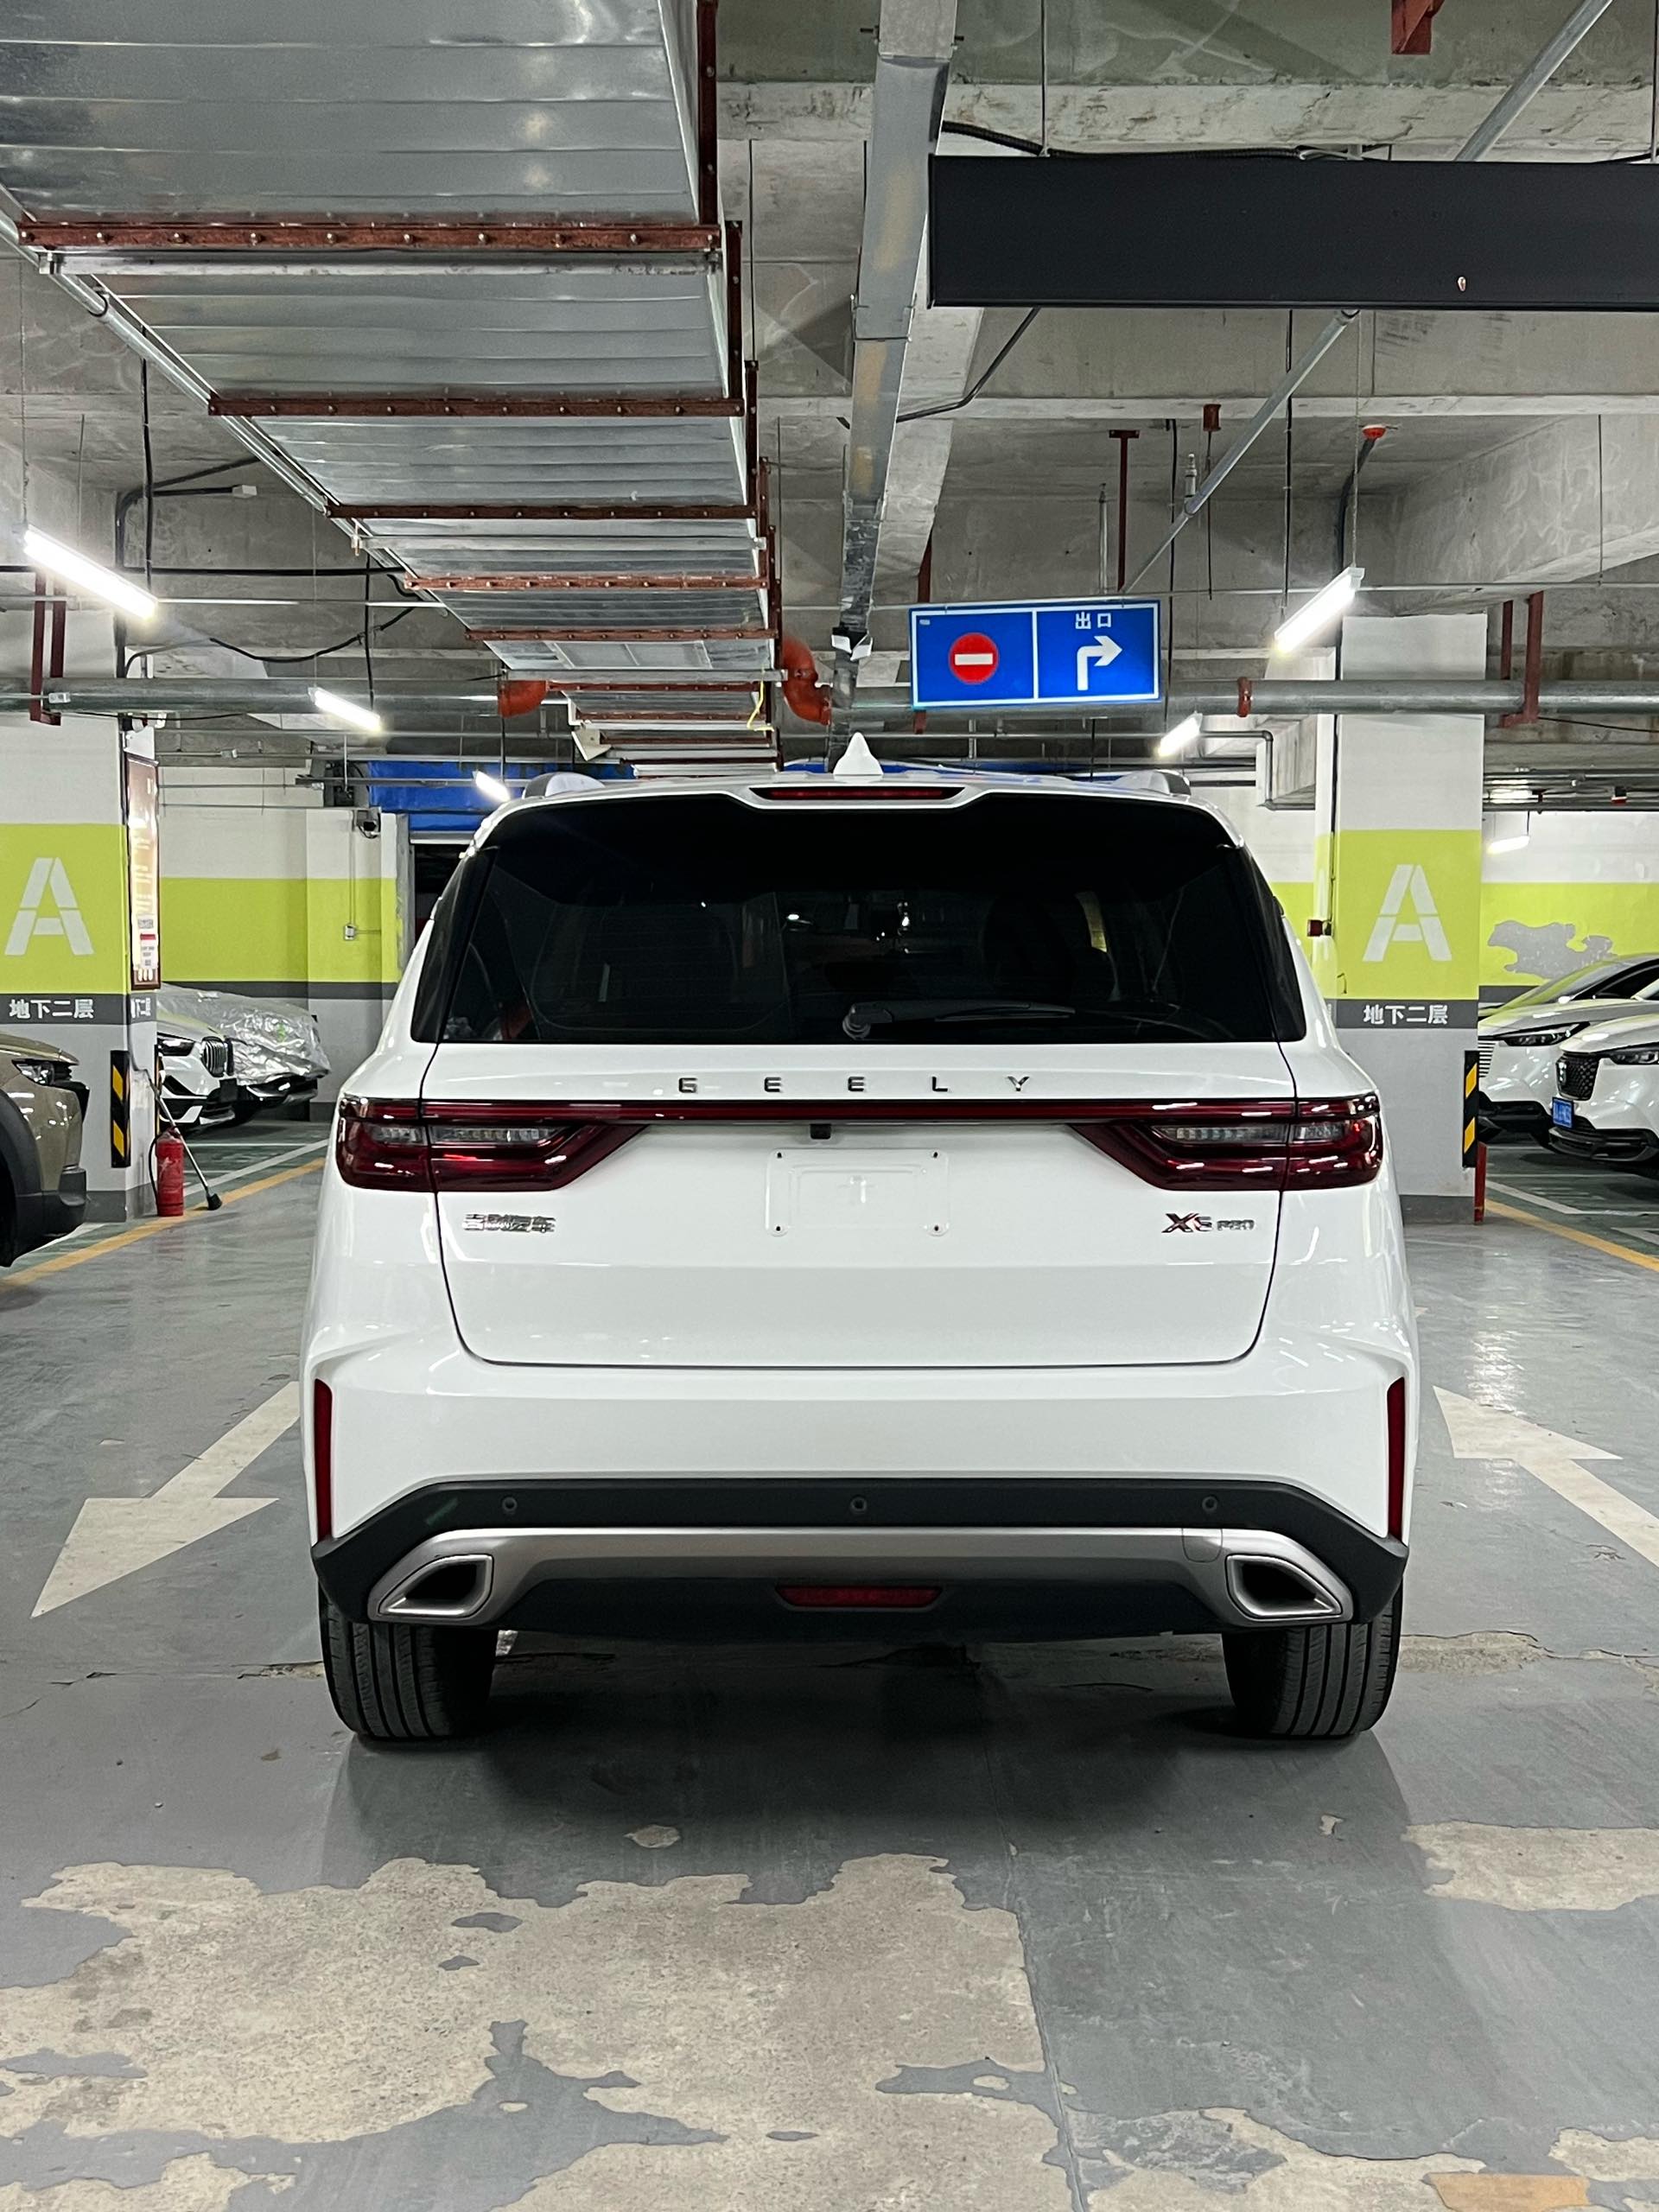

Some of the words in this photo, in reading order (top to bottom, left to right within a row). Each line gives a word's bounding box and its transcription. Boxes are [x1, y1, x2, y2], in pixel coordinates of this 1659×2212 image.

[1075, 611, 1112, 630] 出口
[4, 856, 94, 957] A
[1362, 863, 1452, 963] A
[9, 998, 94, 1019] 地下二层
[1363, 1004, 1448, 1025] 地下二层
[678, 1076, 1030, 1094] GEELY
